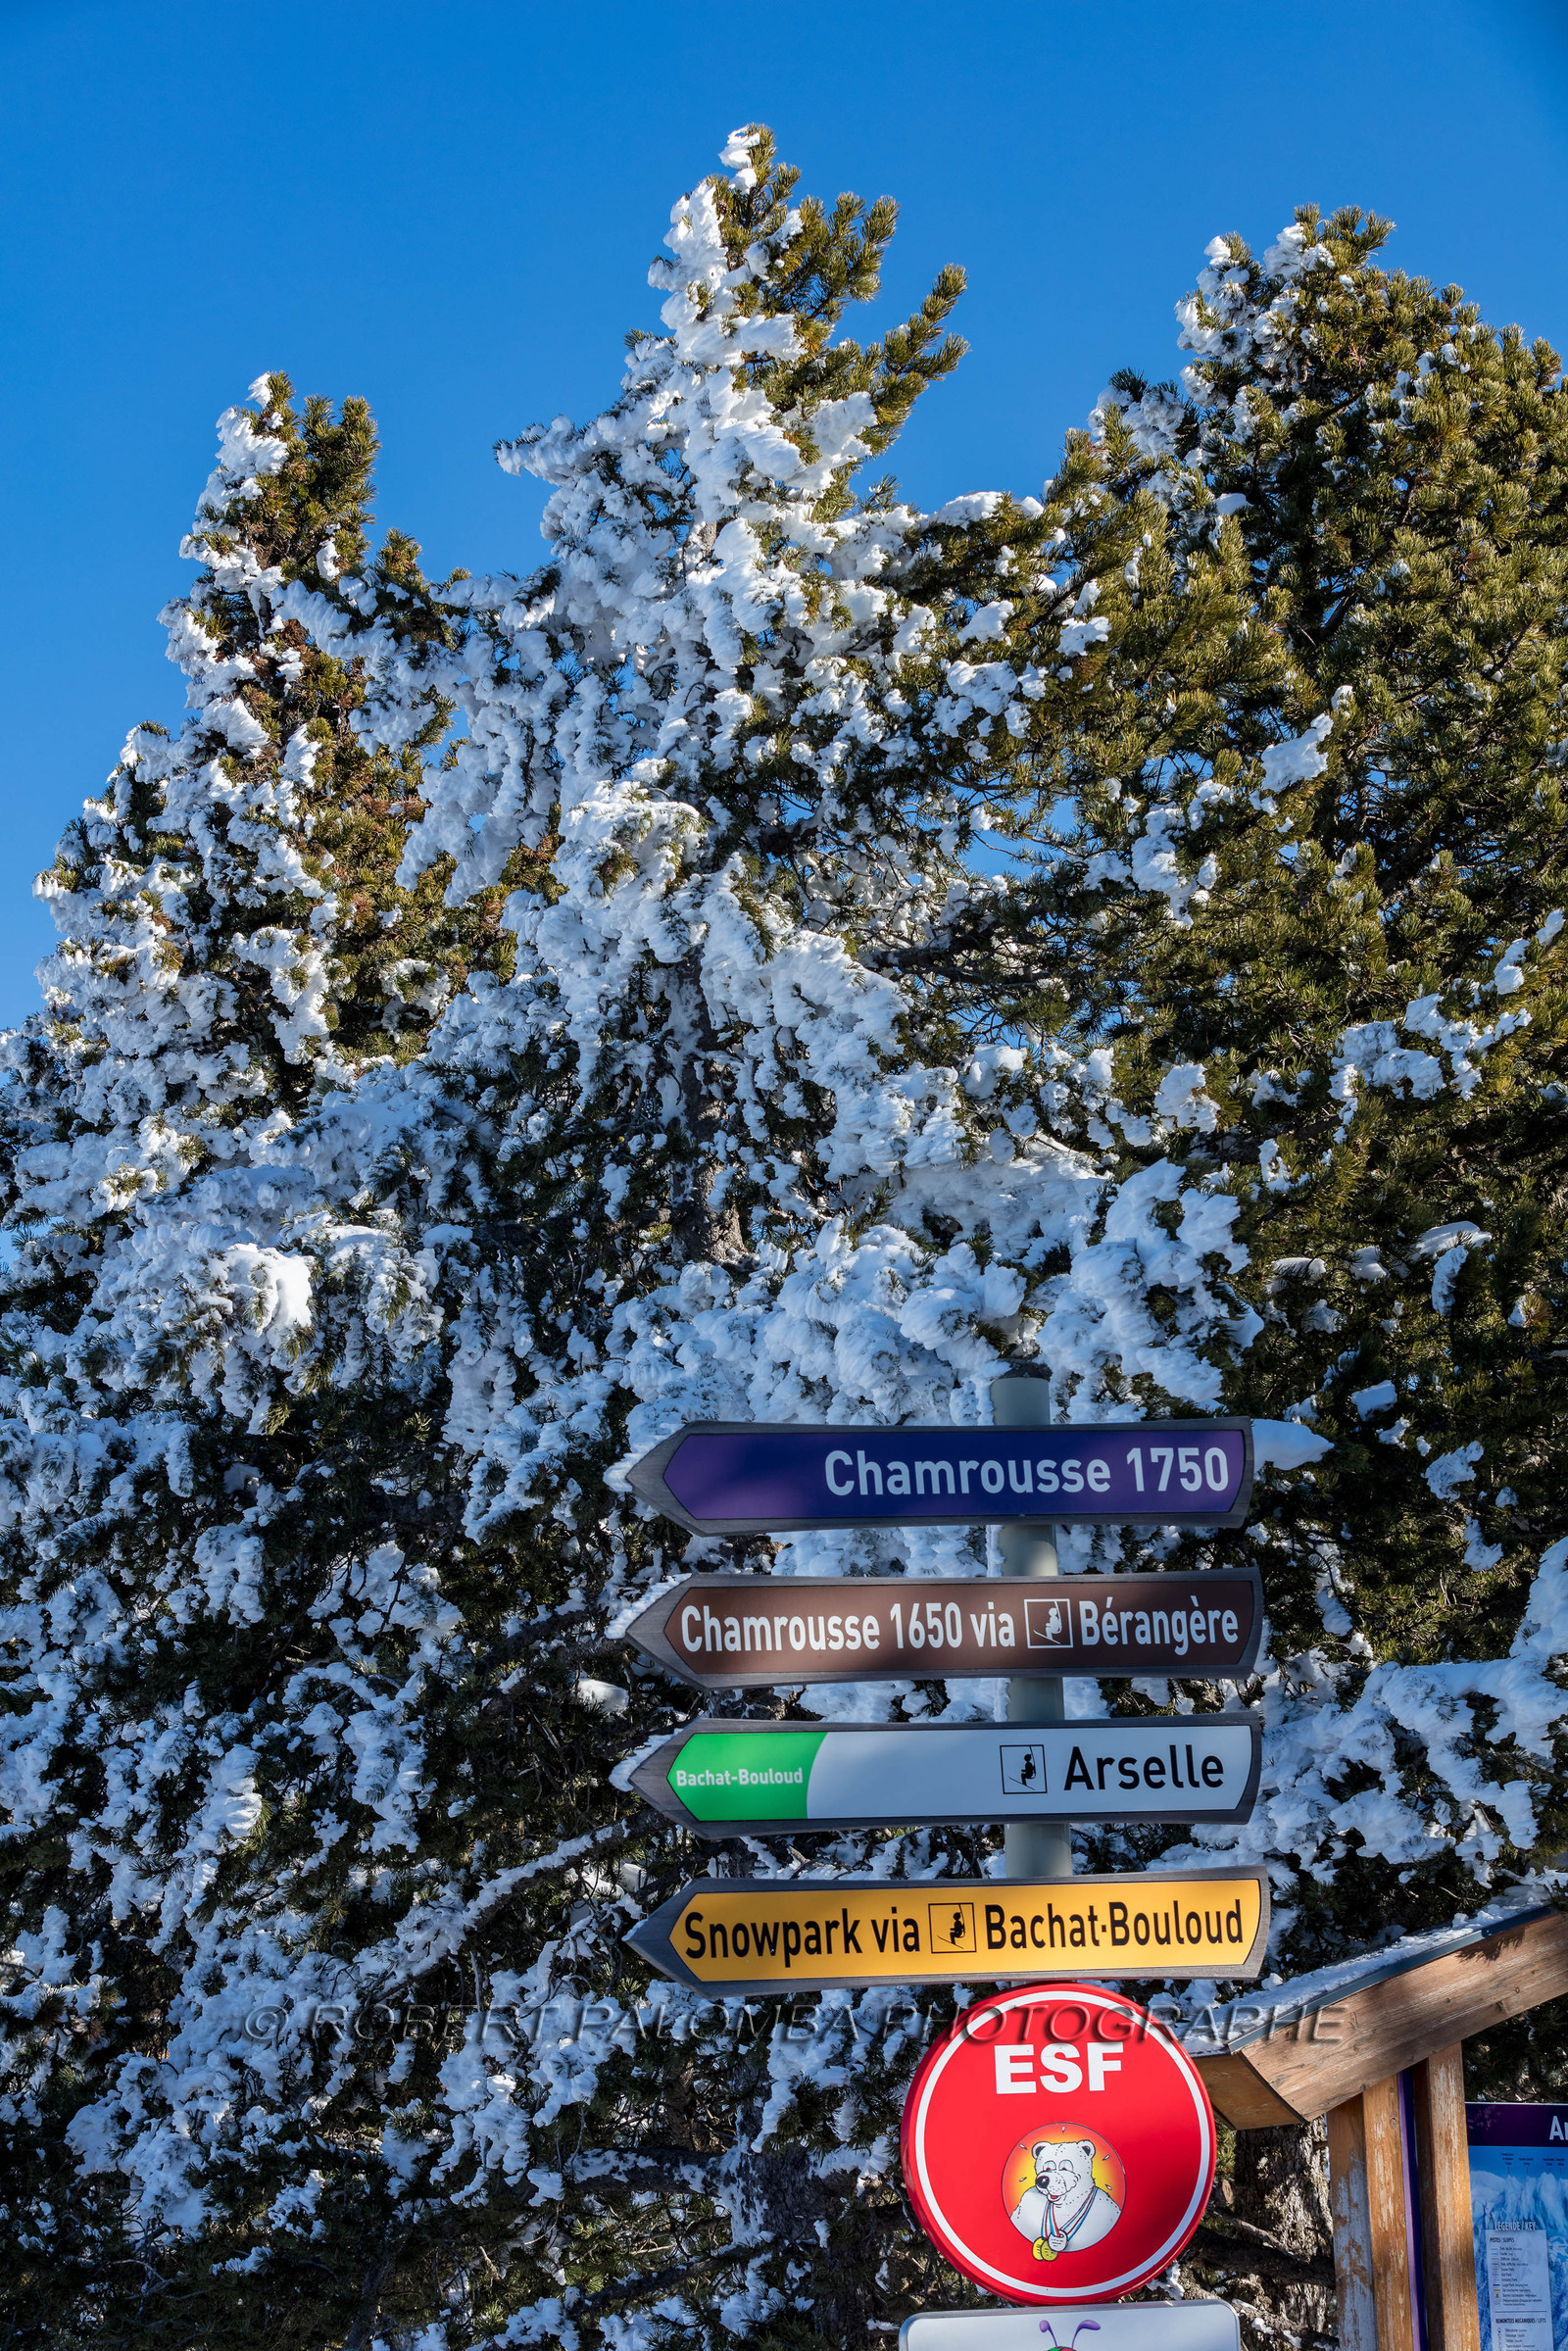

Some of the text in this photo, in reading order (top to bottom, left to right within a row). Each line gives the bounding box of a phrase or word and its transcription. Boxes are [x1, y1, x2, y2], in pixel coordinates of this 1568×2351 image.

[824, 1447, 1229, 1496] Chamrousse 1750
[681, 1594, 1239, 1655] Chamrousse 1650 via Bérangère
[675, 1768, 804, 1788] Bachat-Bouloud
[1062, 1744, 1225, 1791] Arselle
[686, 1908, 862, 1968] Snowpark
[874, 1906, 920, 1953] via
[994, 2041, 1124, 2095] ESF
